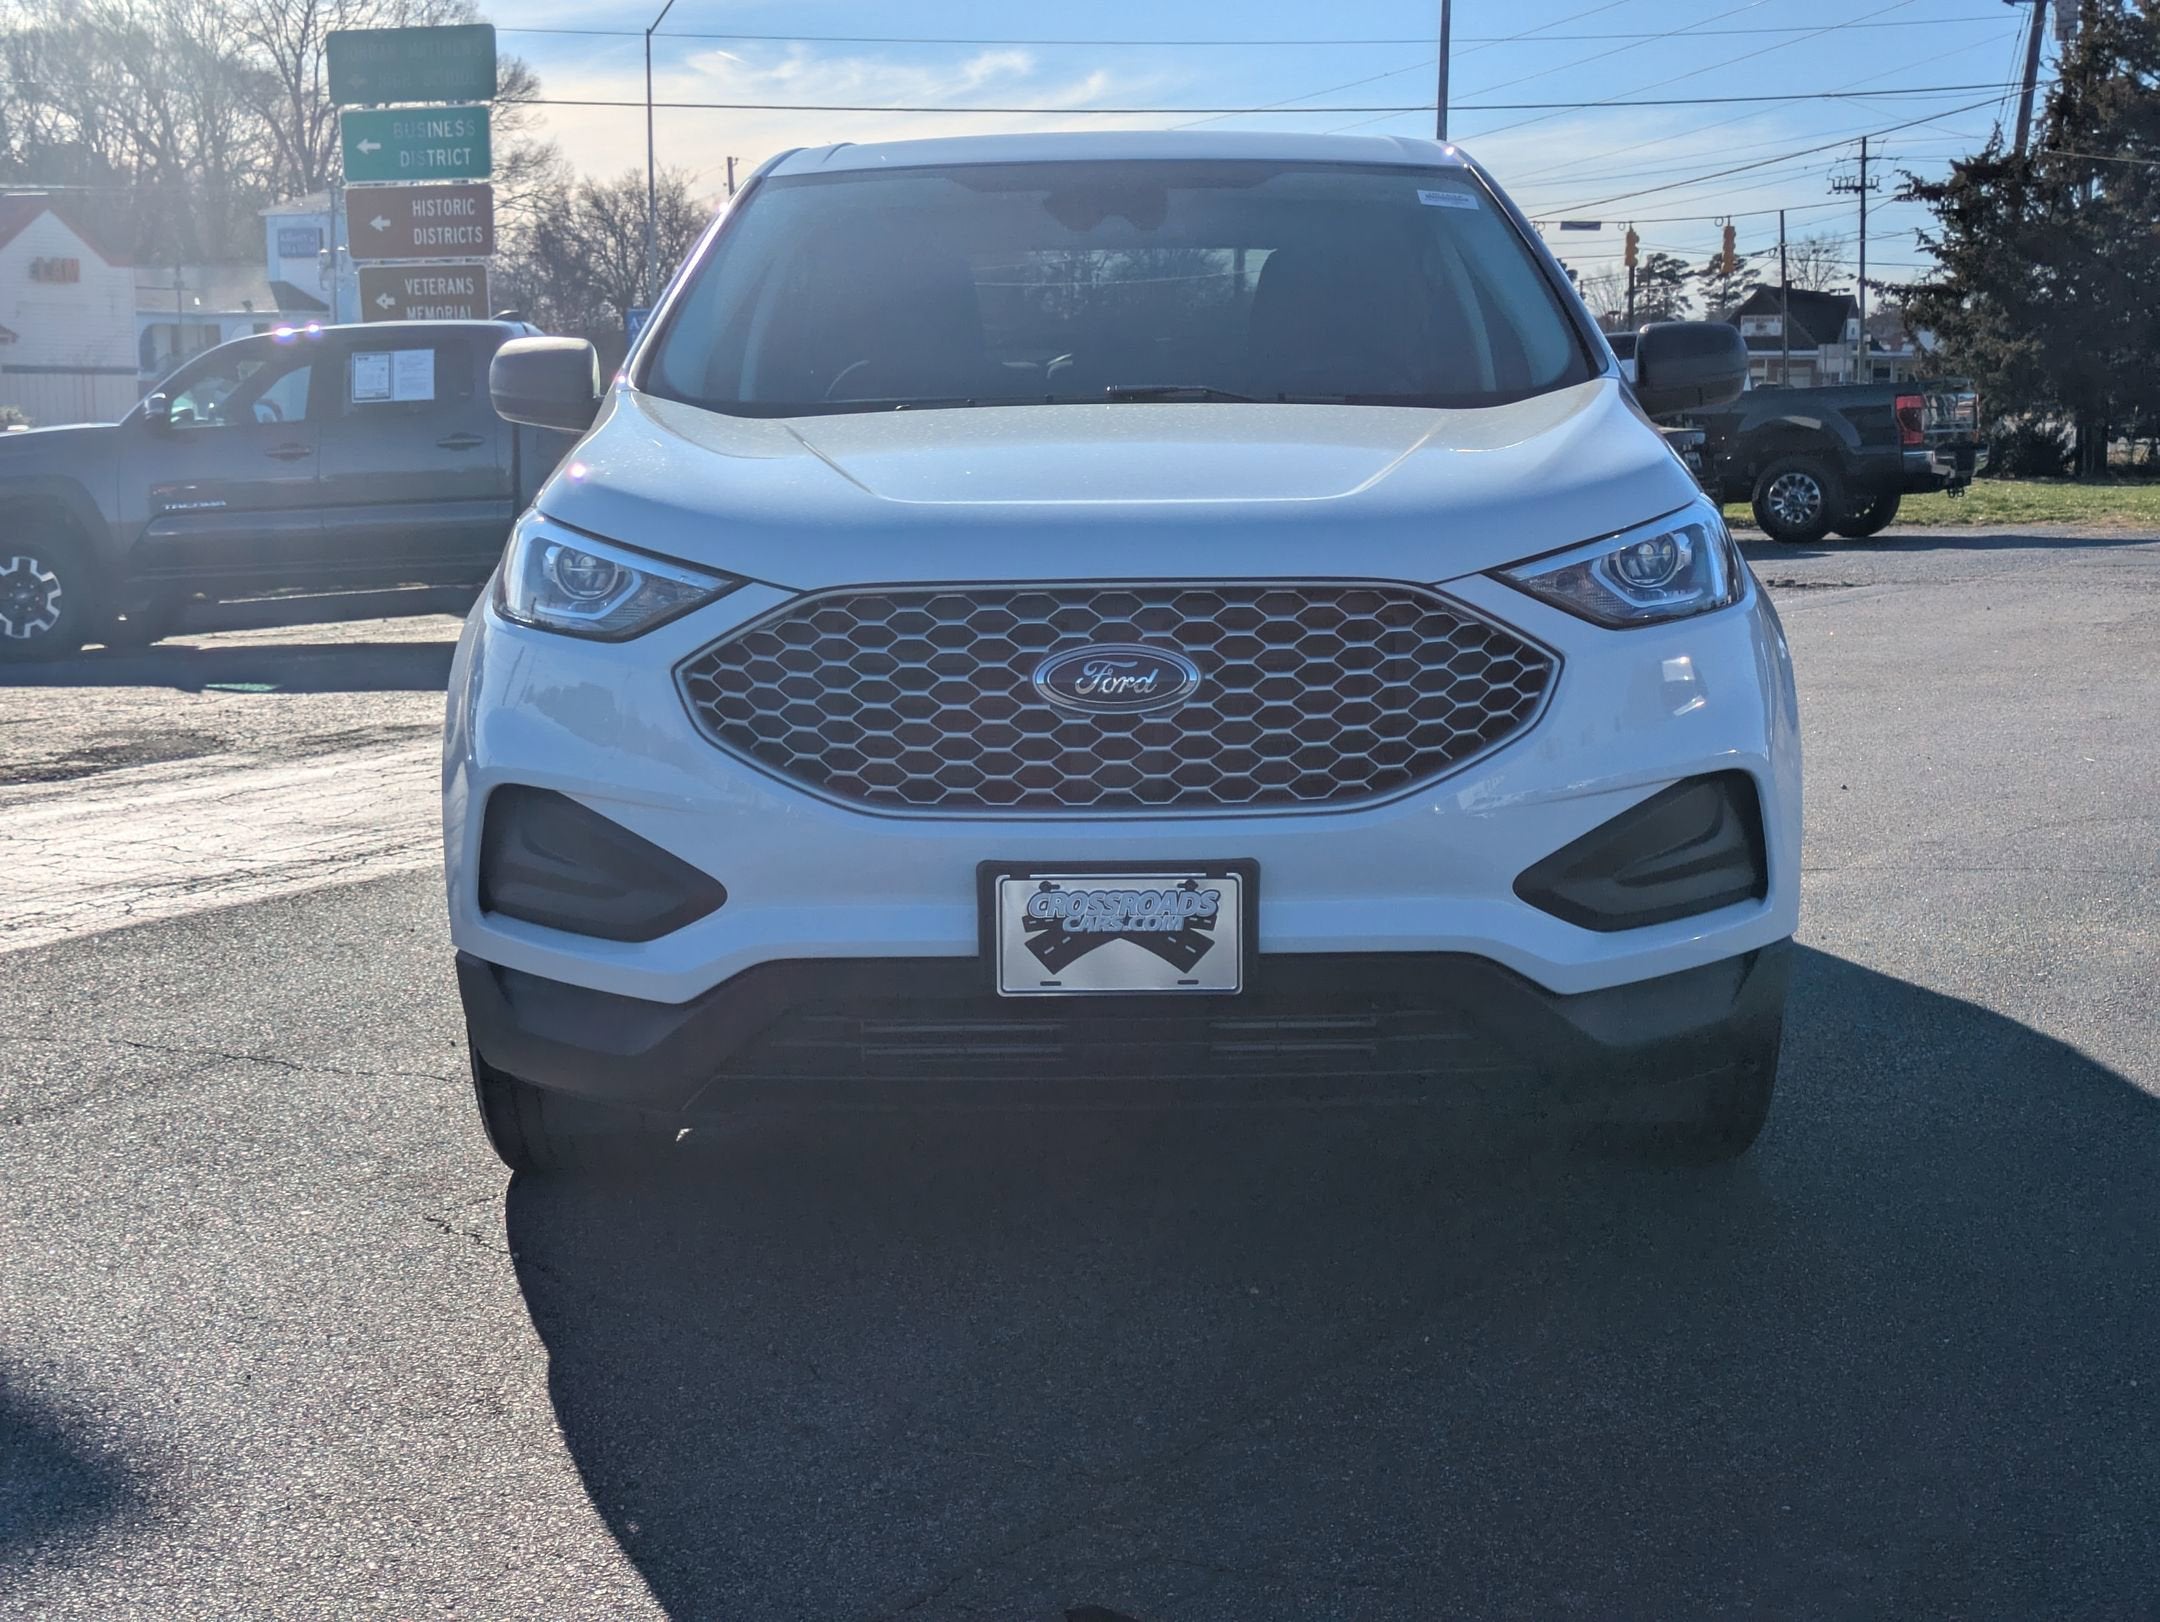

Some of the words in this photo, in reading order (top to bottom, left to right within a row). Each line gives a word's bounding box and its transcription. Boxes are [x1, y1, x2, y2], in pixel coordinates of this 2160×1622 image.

[393, 119, 476, 138] BUSINESS
[400, 148, 471, 167] DISTRICT
[412, 198, 475, 216] HISTORIC
[414, 226, 483, 245] DISTRICTS
[404, 277, 474, 295] VETERANS
[1074, 660, 1159, 695] Ford
[1027, 889, 1221, 919] CROSSROADS
[1062, 915, 1184, 933] CARS.COM
